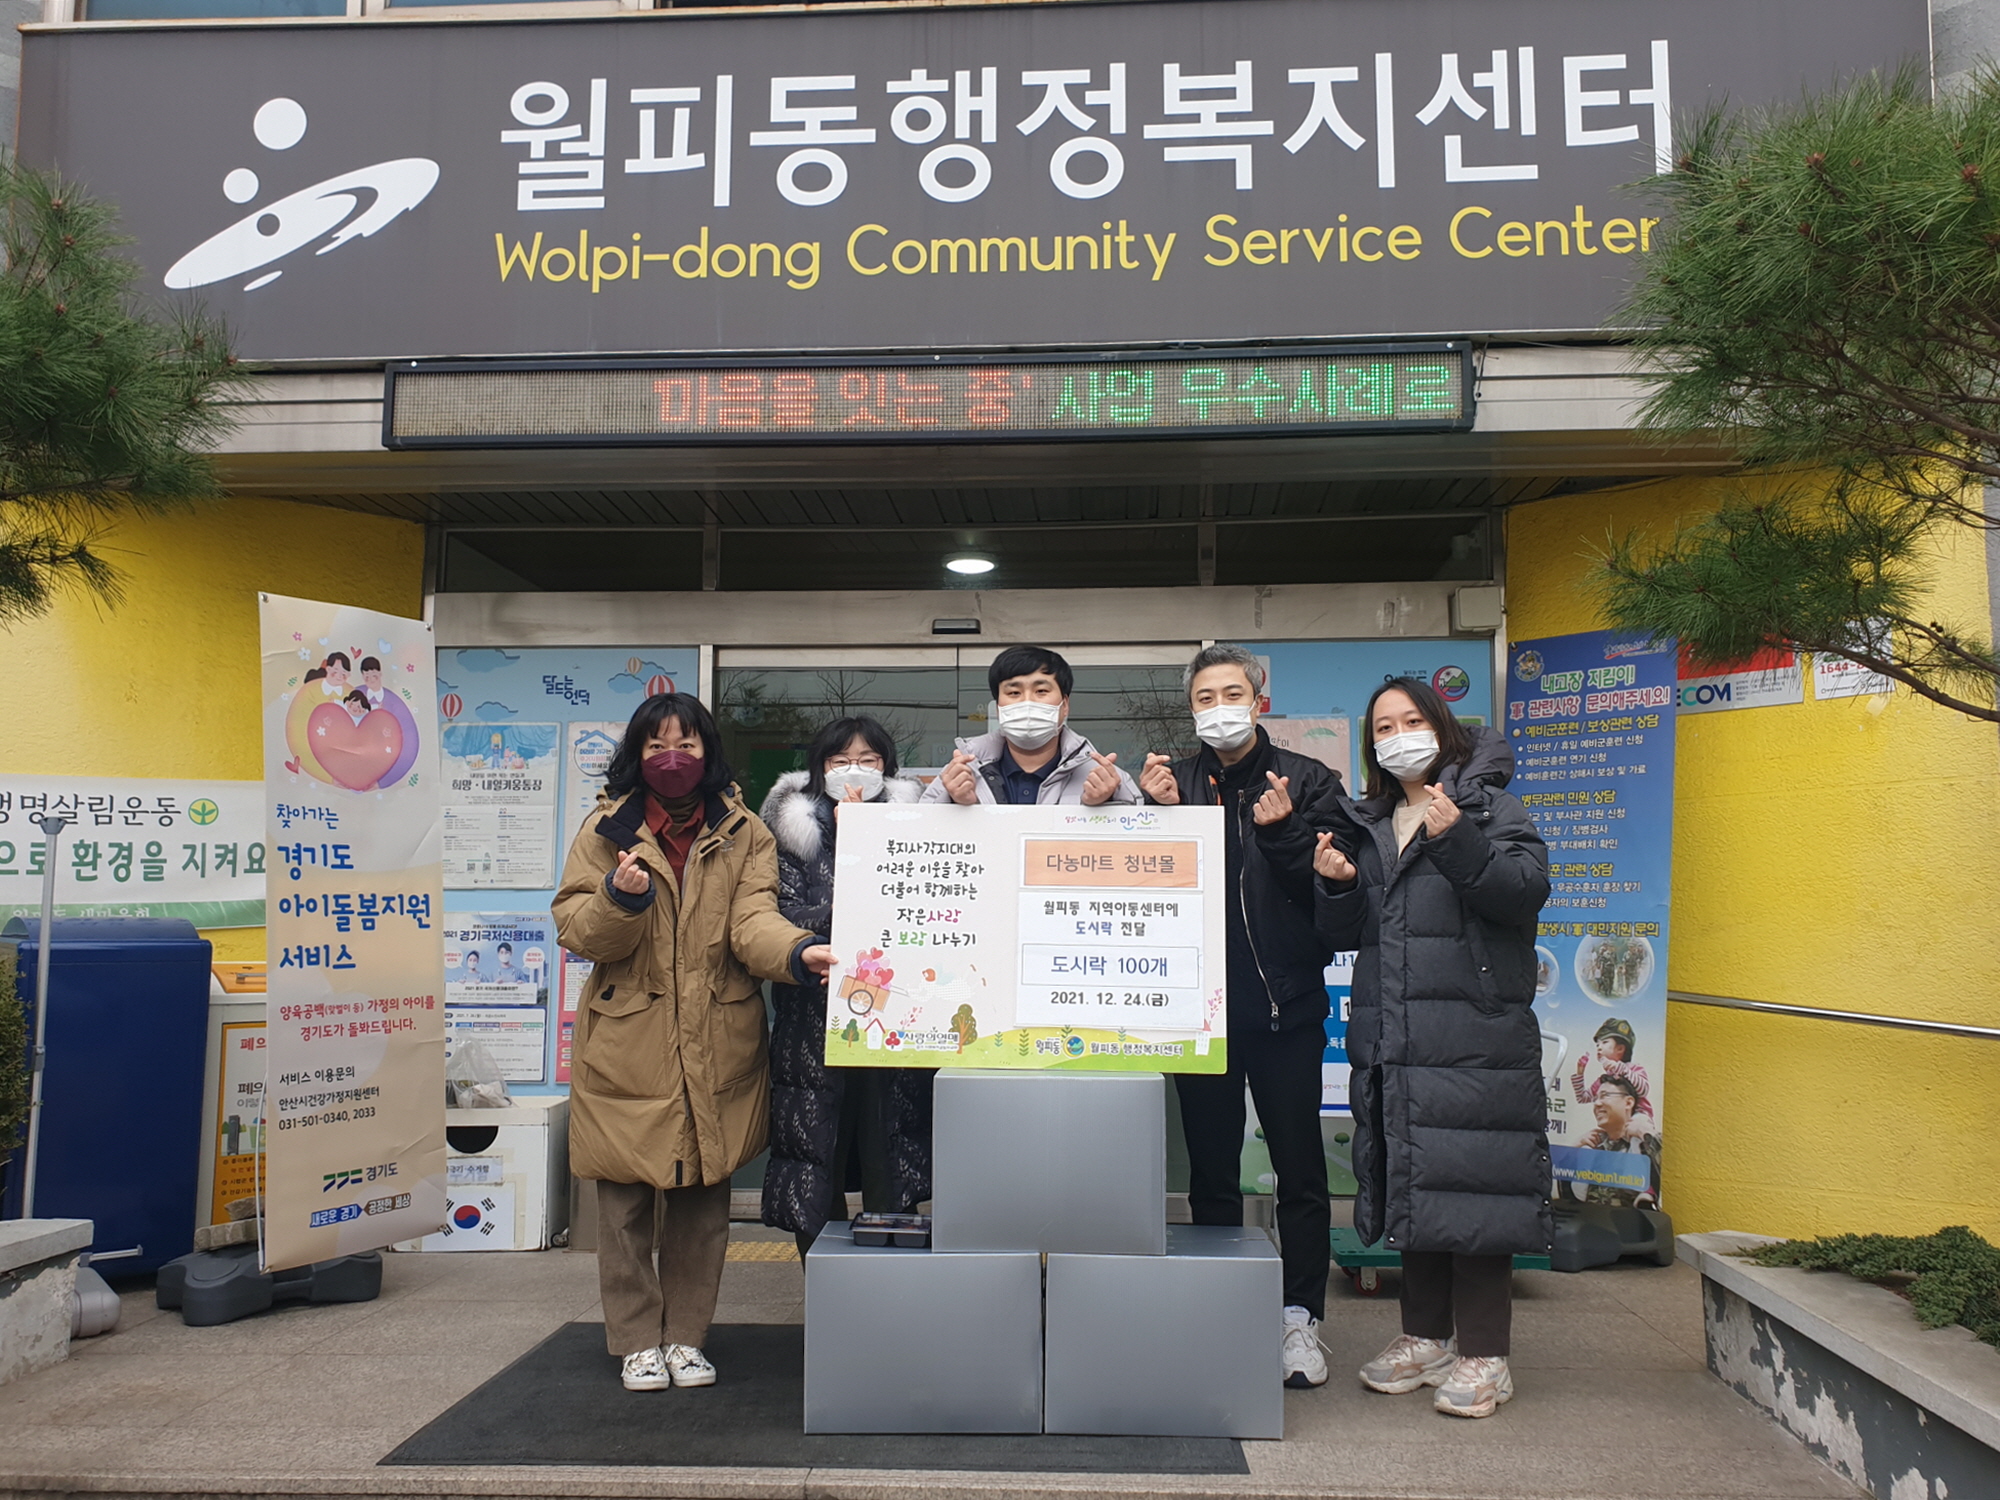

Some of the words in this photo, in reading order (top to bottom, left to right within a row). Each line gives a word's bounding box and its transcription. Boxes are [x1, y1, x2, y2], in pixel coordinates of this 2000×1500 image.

[500, 40, 1673, 212] 월피동행정복지센터
[496, 224, 820, 293] Wolpi-dong
[847, 213, 1177, 281] Community
[1204, 214, 1422, 266] Service
[1448, 205, 1660, 260] Center
[653, 373, 819, 425] 마음을
[839, 372, 943, 424] 잇는
[1051, 369, 1154, 422] 사업
[1178, 363, 1455, 420] 우수사례로
[1540, 670, 1585, 694] 내고장
[1587, 664, 1636, 689] 지킴이!
[563, 689, 590, 705] 언덕
[1528, 695, 1581, 718] 관련사항
[1585, 686, 1671, 714] 문의해주세요!
[1676, 682, 1731, 706] COM
[1635, 714, 1660, 729] 상담
[1526, 742, 1552, 753] 인터넷
[1561, 740, 1578, 750] 휴일
[1580, 736, 1623, 749] 예비군훈련
[1625, 734, 1644, 746] 신청
[1525, 755, 1567, 767] 예비군훈련
[1569, 754, 1587, 764] 연기
[1589, 752, 1607, 763] 신청
[1521, 792, 1565, 808] 병무관련
[1567, 790, 1590, 806] 민원
[1593, 789, 1617, 805] 상담
[276, 804, 340, 830] 찾아가는
[1529, 812, 1541, 822] 교
[1556, 810, 1583, 821] 부사관
[1586, 808, 1604, 820] 지원
[1607, 807, 1626, 819] 신청
[1543, 826, 1561, 837] 신청
[1571, 823, 1609, 835] 징병검사
[886, 839, 976, 857] 복지사각지대의
[1560, 839, 1597, 850] 부대배치
[1599, 838, 1618, 849] 확인
[71, 839, 168, 883] 환경을
[181, 842, 266, 879] 지켜요
[276, 842, 355, 881] 경기도
[876, 861, 915, 878] 어려운
[919, 861, 951, 879] 이웃을
[955, 861, 985, 878] 찾아
[1046, 854, 1114, 873] 다농마트
[1124, 854, 1176, 874] 청년몰
[1548, 863, 1562, 878] 훈
[1564, 862, 1587, 878] 관련
[1590, 862, 1615, 878] 상담
[881, 881, 919, 899] 더불어
[924, 882, 978, 900] 함께하는
[1043, 900, 1081, 916] 월피동
[1089, 901, 1179, 918] 지역아동센터에
[1571, 897, 1607, 908] 보훈신청
[279, 893, 432, 932] 아이돌봄지원
[460, 930, 545, 942] 경기극저신용대출
[880, 929, 892, 948] 큰
[897, 931, 928, 946] 보람
[932, 932, 976, 947] 나누기
[1075, 921, 1113, 936] 도시락
[1120, 922, 1146, 937] 전달
[1586, 922, 1632, 937] 대민지원
[1634, 922, 1660, 937] 문의
[279, 944, 357, 970] 서비스
[1050, 956, 1108, 976] 도시락
[1117, 957, 1169, 977] 100개
[367, 998, 400, 1014] 가정의
[402, 995, 436, 1011] 아이를
[1050, 991, 1089, 1005] 2021.
[1096, 993, 1117, 1006] 12.
[1123, 993, 1170, 1007] 24.(금)
[300, 1023, 344, 1042] 경기도가
[347, 1017, 417, 1038] 돌봐드립니다.
[1090, 1042, 1120, 1054] 월피동
[1123, 1044, 1184, 1056] 행정복지센터
[279, 1071, 311, 1086] 서비스
[314, 1066, 356, 1083] 이용문의
[279, 1086, 380, 1111] 안산시건강가정지원센터
[279, 1110, 351, 1131] 031-501-0340,
[352, 1106, 376, 1120] 2033
[366, 1162, 398, 1181] 경기도
[310, 1208, 337, 1227] 새로운
[340, 1204, 359, 1221] 경기
[368, 1197, 393, 1215] 공정한
[394, 1193, 411, 1209] 세상
